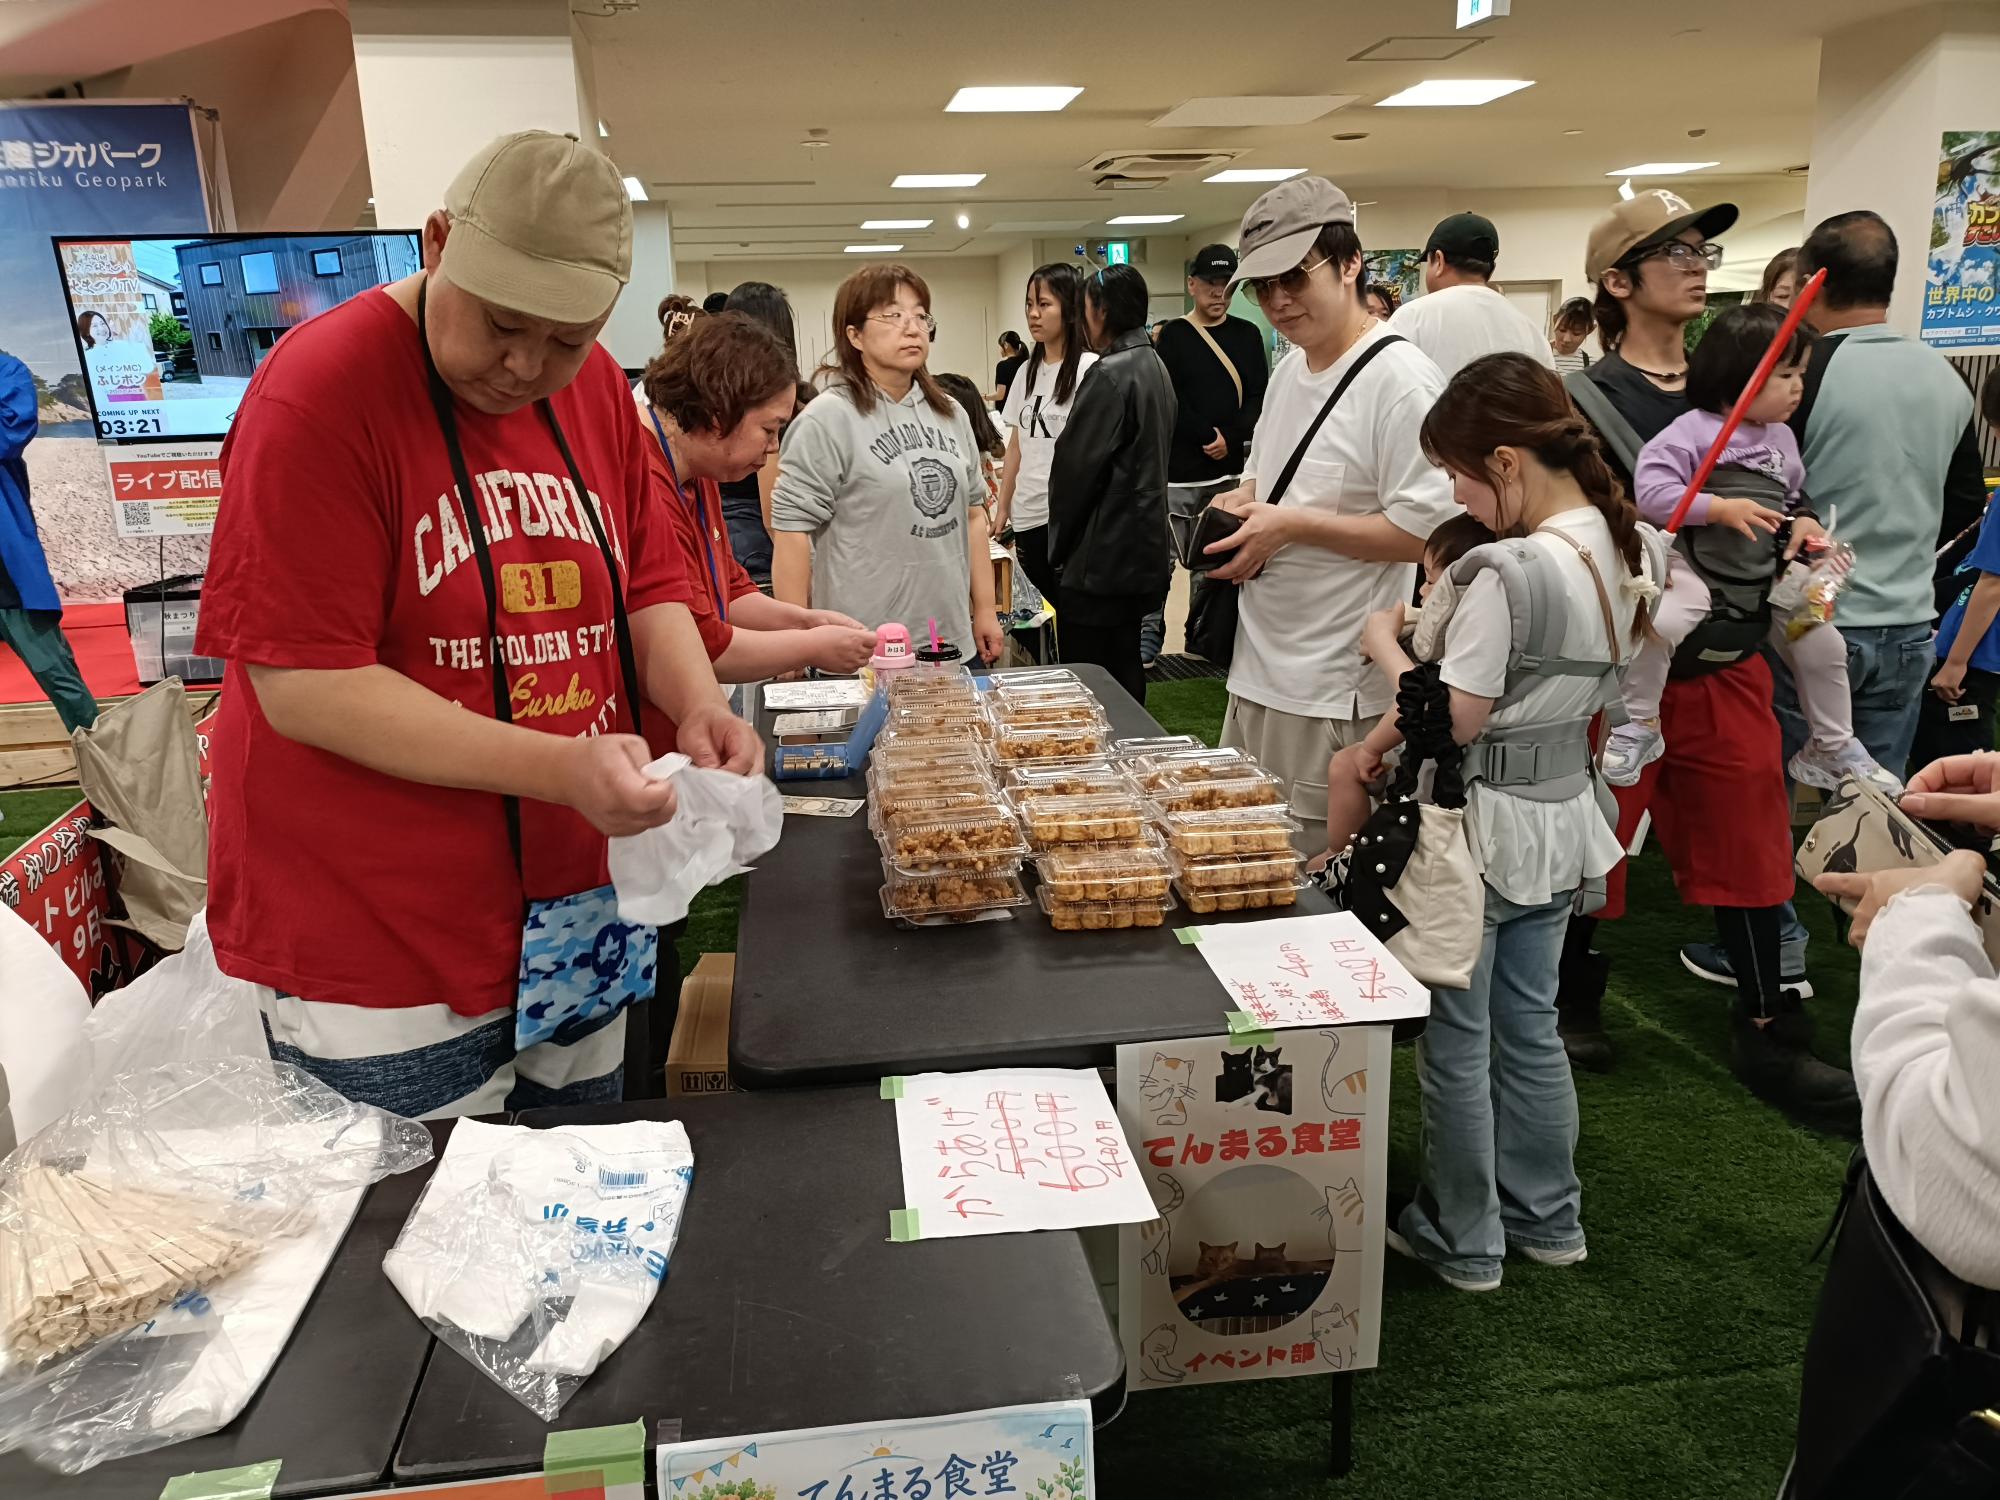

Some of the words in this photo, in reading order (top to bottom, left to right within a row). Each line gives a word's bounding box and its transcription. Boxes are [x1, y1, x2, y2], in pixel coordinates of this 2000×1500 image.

[76, 171, 167, 192] Geopark
[1928, 286, 1995, 305] 世界中の
[100, 419, 161, 435] 03:21
[519, 568, 557, 607] 31
[429, 637, 483, 670] THE
[510, 672, 595, 720] Eureka
[924, 1097, 1004, 1218] からあげ
[1142, 1118, 1362, 1169] てんまる食堂
[1184, 1342, 1316, 1372] イベント部
